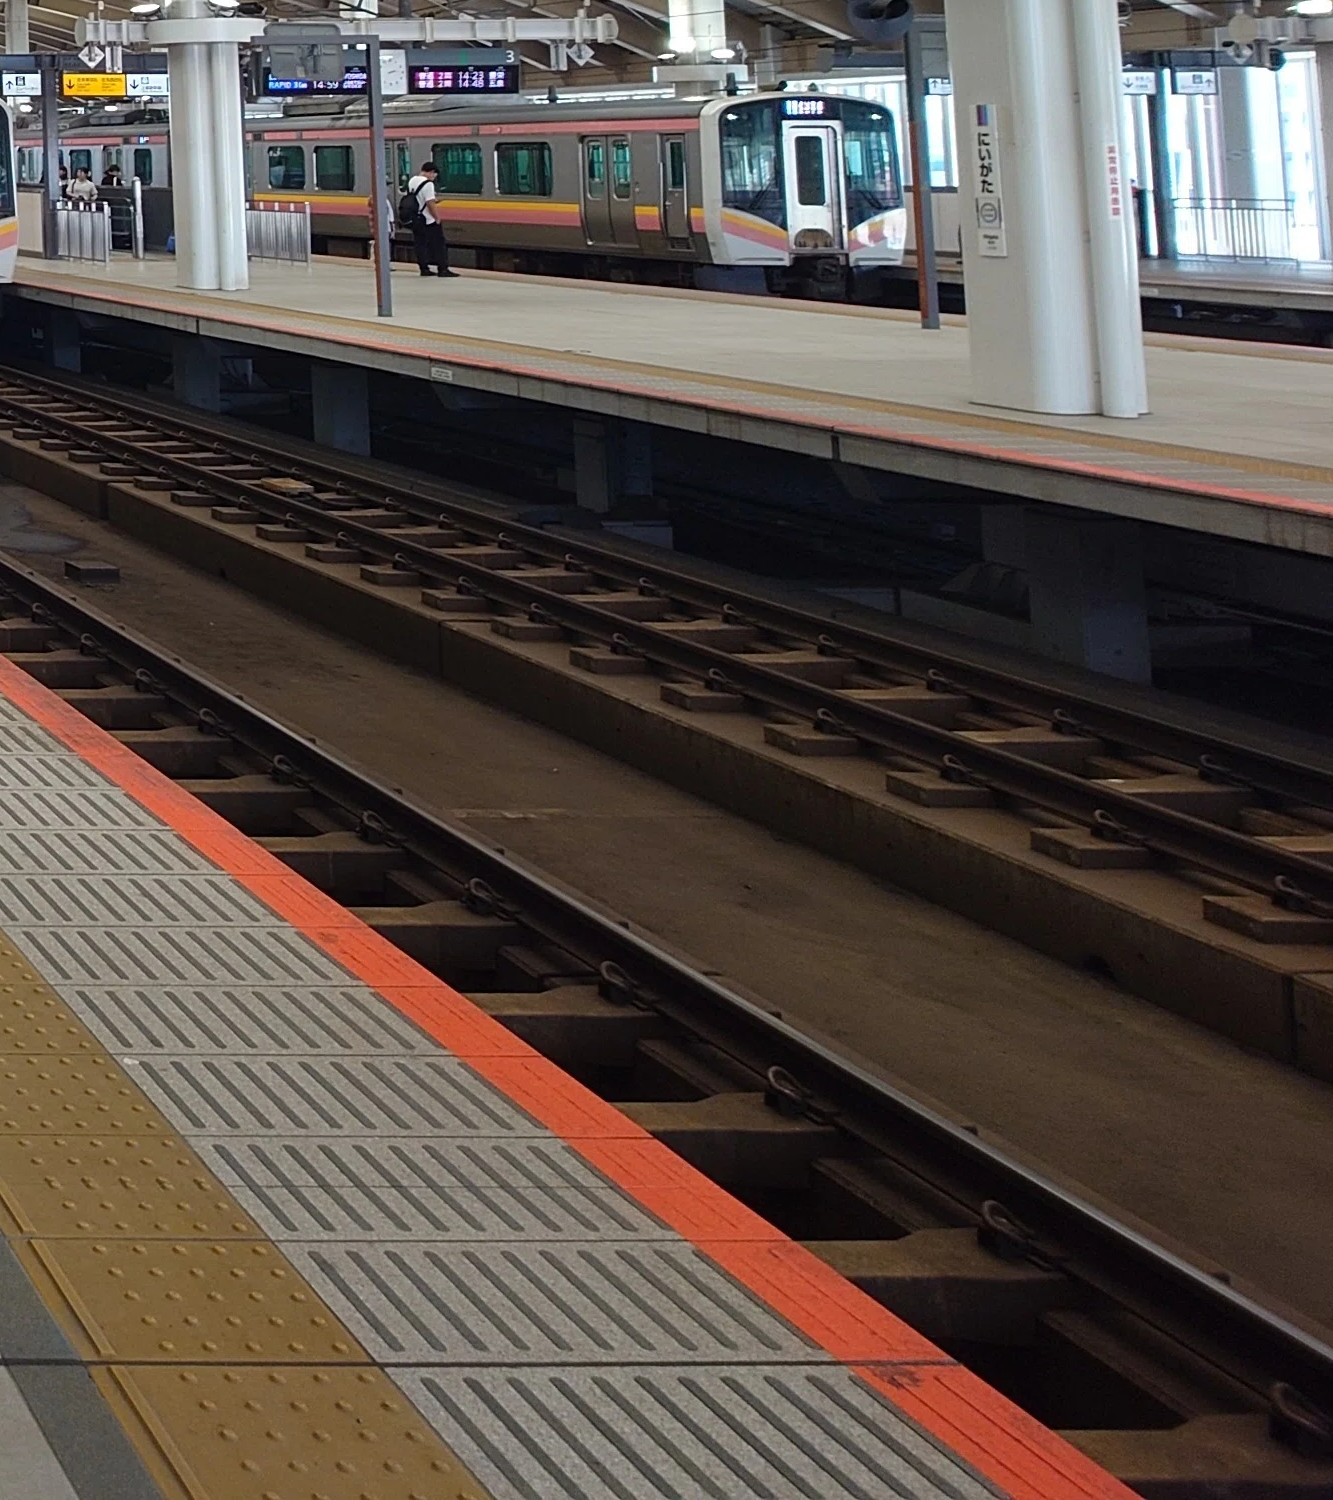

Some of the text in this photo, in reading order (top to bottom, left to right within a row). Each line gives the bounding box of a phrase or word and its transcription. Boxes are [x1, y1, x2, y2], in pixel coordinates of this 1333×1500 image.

[505, 50, 515, 63] 3
[458, 72, 485, 80] 14:23
[268, 81, 292, 89] RAPID
[977, 132, 994, 194] にいがた
